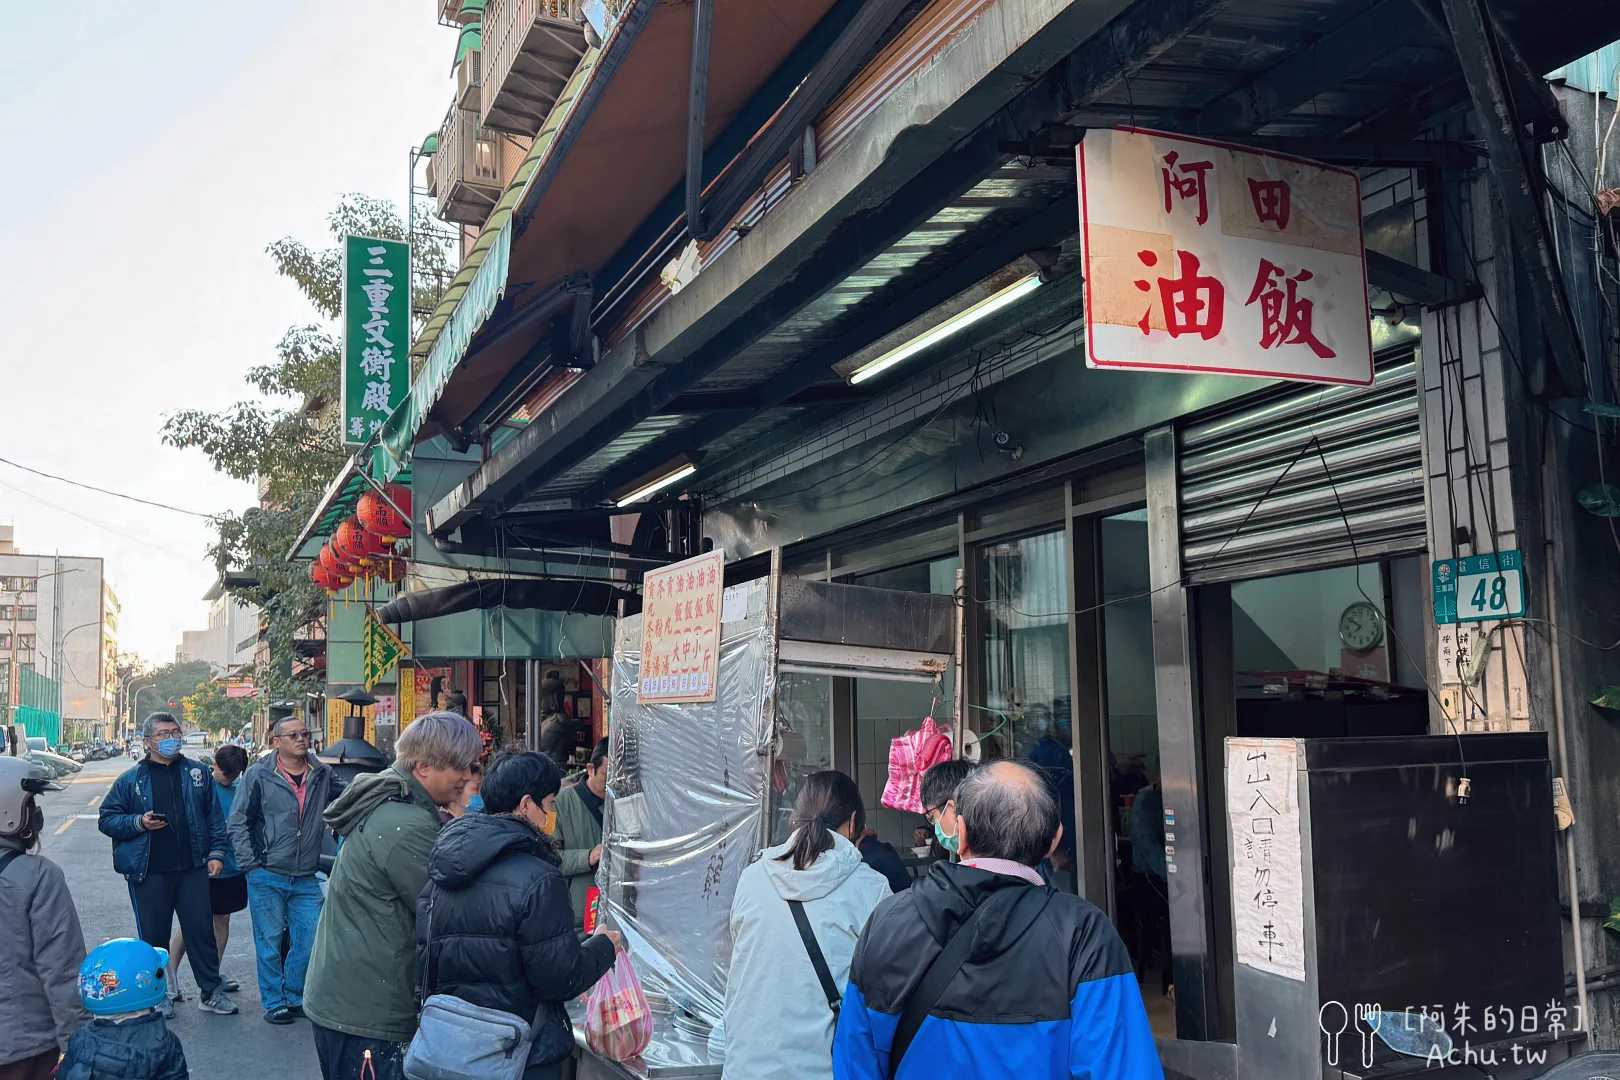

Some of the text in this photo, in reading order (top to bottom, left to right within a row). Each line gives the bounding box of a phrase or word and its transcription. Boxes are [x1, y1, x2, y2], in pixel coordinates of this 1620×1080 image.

[1162, 150, 1291, 230] 阿田
[359, 245, 396, 416] 三重文衡殿
[1133, 249, 1337, 359] 油飯
[1456, 554, 1514, 573] 電信街
[1471, 576, 1507, 612] 48
[1244, 750, 1284, 962] 出入口請勿停車
